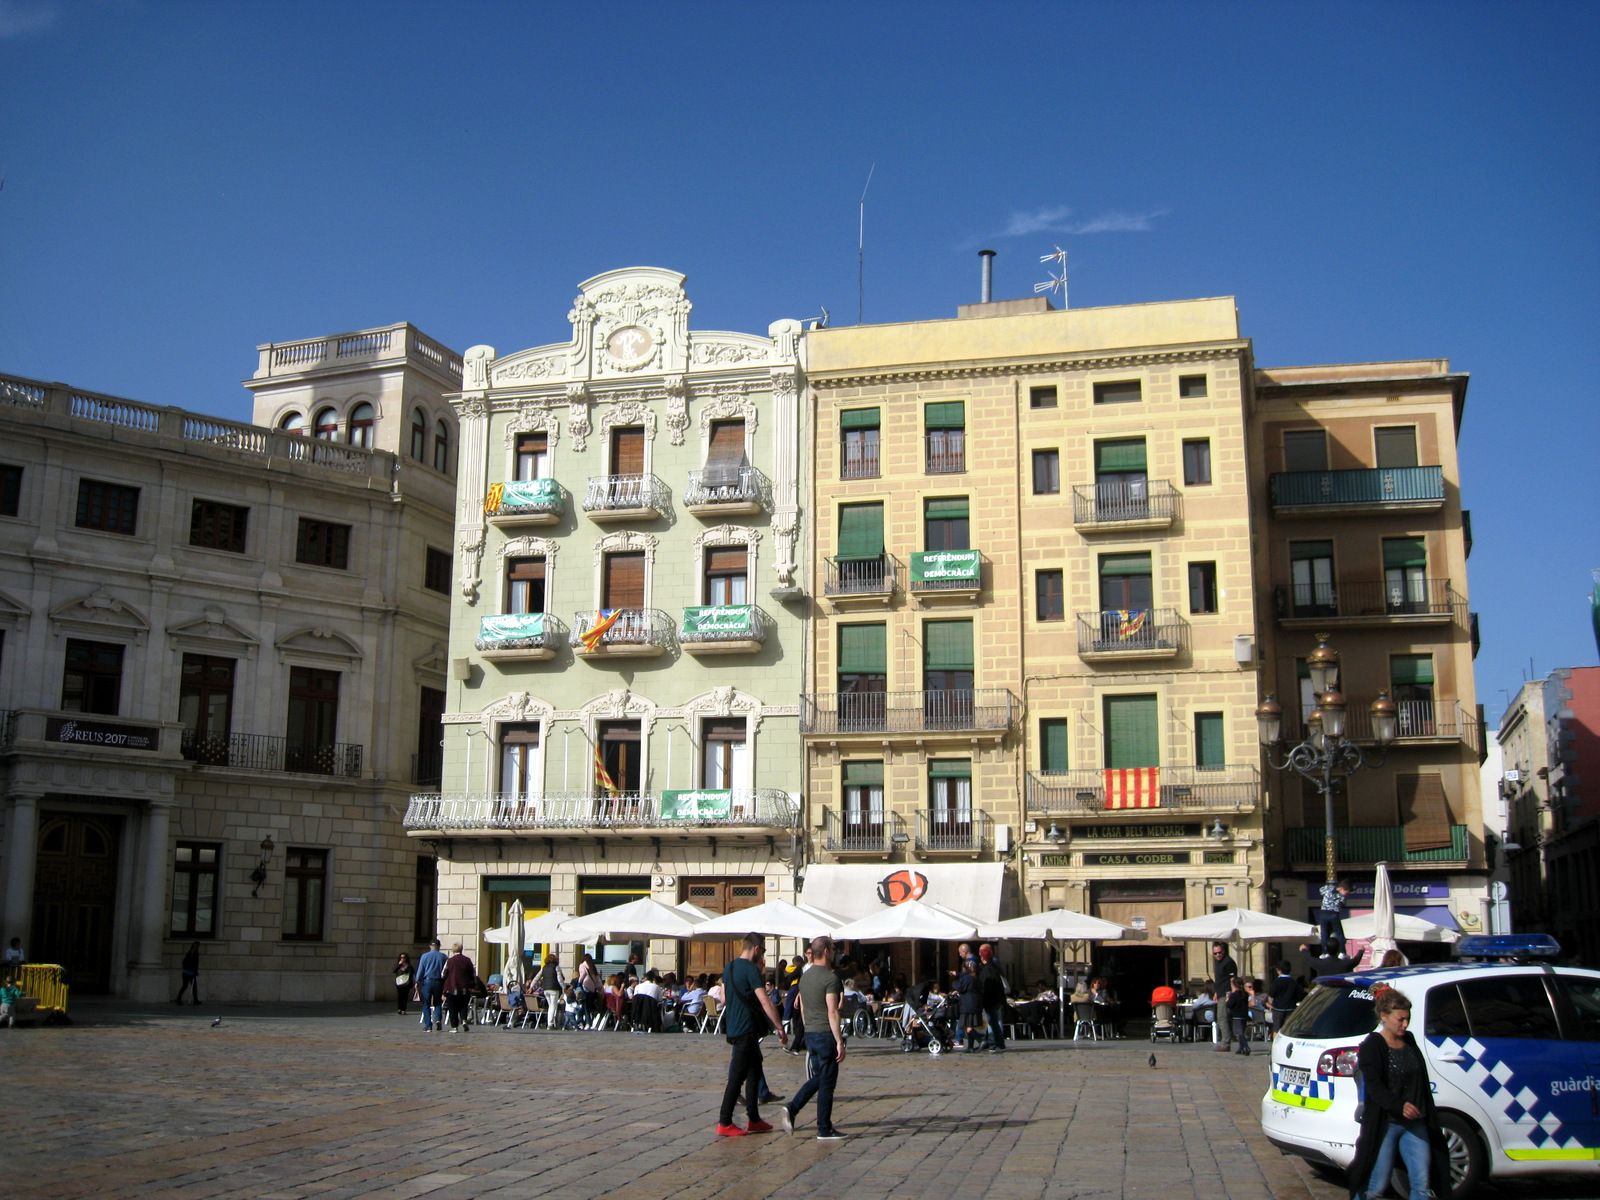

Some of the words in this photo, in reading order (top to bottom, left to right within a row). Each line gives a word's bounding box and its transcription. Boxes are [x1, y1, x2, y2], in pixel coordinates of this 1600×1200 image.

[924, 553, 975, 562] REFERÈNDUM
[924, 568, 975, 578] DEMOCRÀCIA
[75, 730, 103, 742] REUS
[104, 733, 127, 744] 2017
[1099, 855, 1129, 865] CASA
[1135, 854, 1174, 864] CODER
[1393, 884, 1429, 896] Dolça
